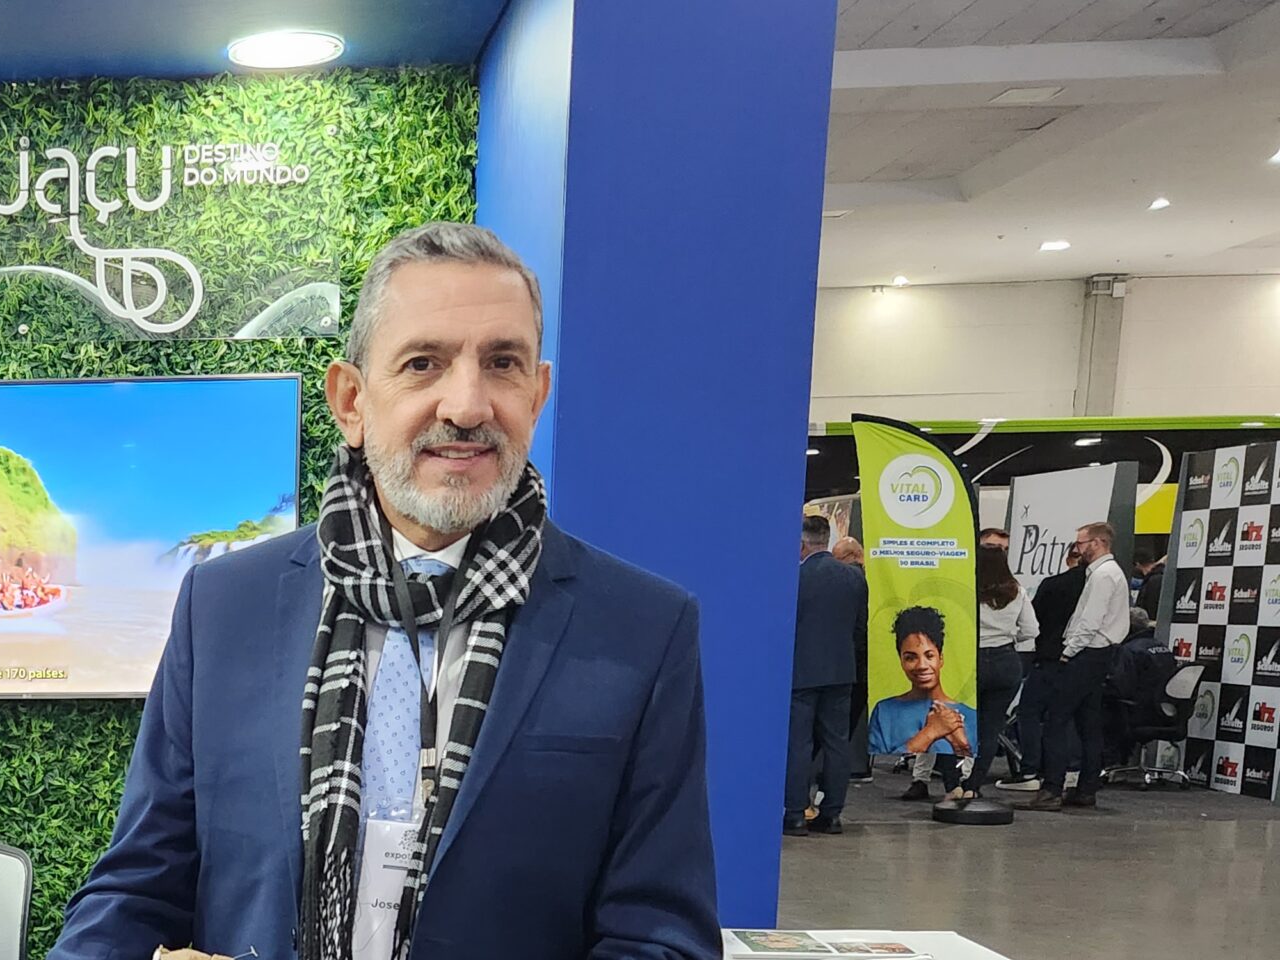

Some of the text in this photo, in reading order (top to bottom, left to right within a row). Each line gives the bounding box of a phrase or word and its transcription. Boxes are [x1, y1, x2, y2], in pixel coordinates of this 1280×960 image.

[183, 142, 279, 164] DESTINO
[183, 163, 310, 187] DO MUNDO
[890, 482, 929, 495] VITAL
[898, 494, 930, 503] CARD
[5, 668, 26, 680] 170
[28, 667, 68, 681] países.
